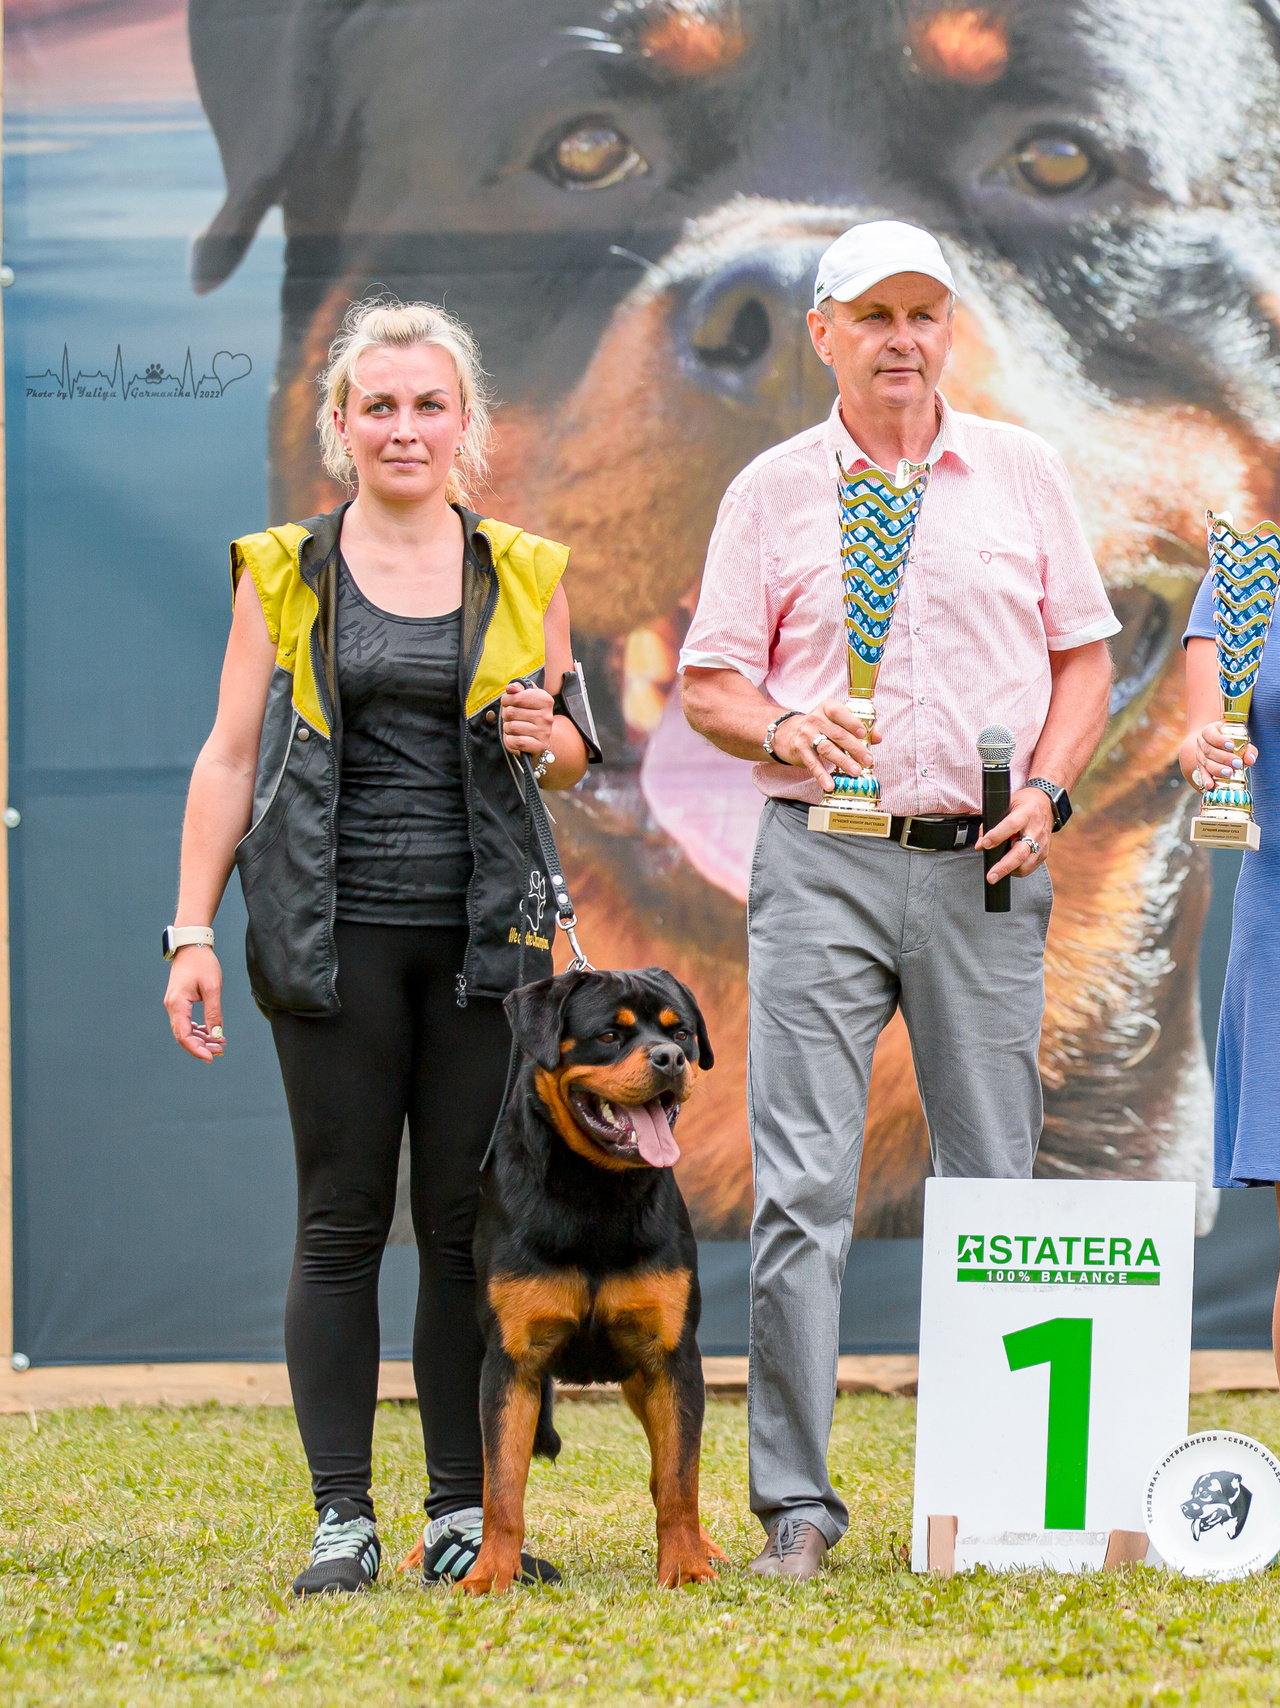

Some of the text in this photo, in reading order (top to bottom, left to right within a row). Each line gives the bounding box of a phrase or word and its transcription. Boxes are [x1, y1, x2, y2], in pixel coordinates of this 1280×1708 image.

[989, 1235, 1160, 1266] STATERA
[986, 1270, 1128, 1284] 100% BALANCE
[1002, 1317, 1093, 1530] 1
